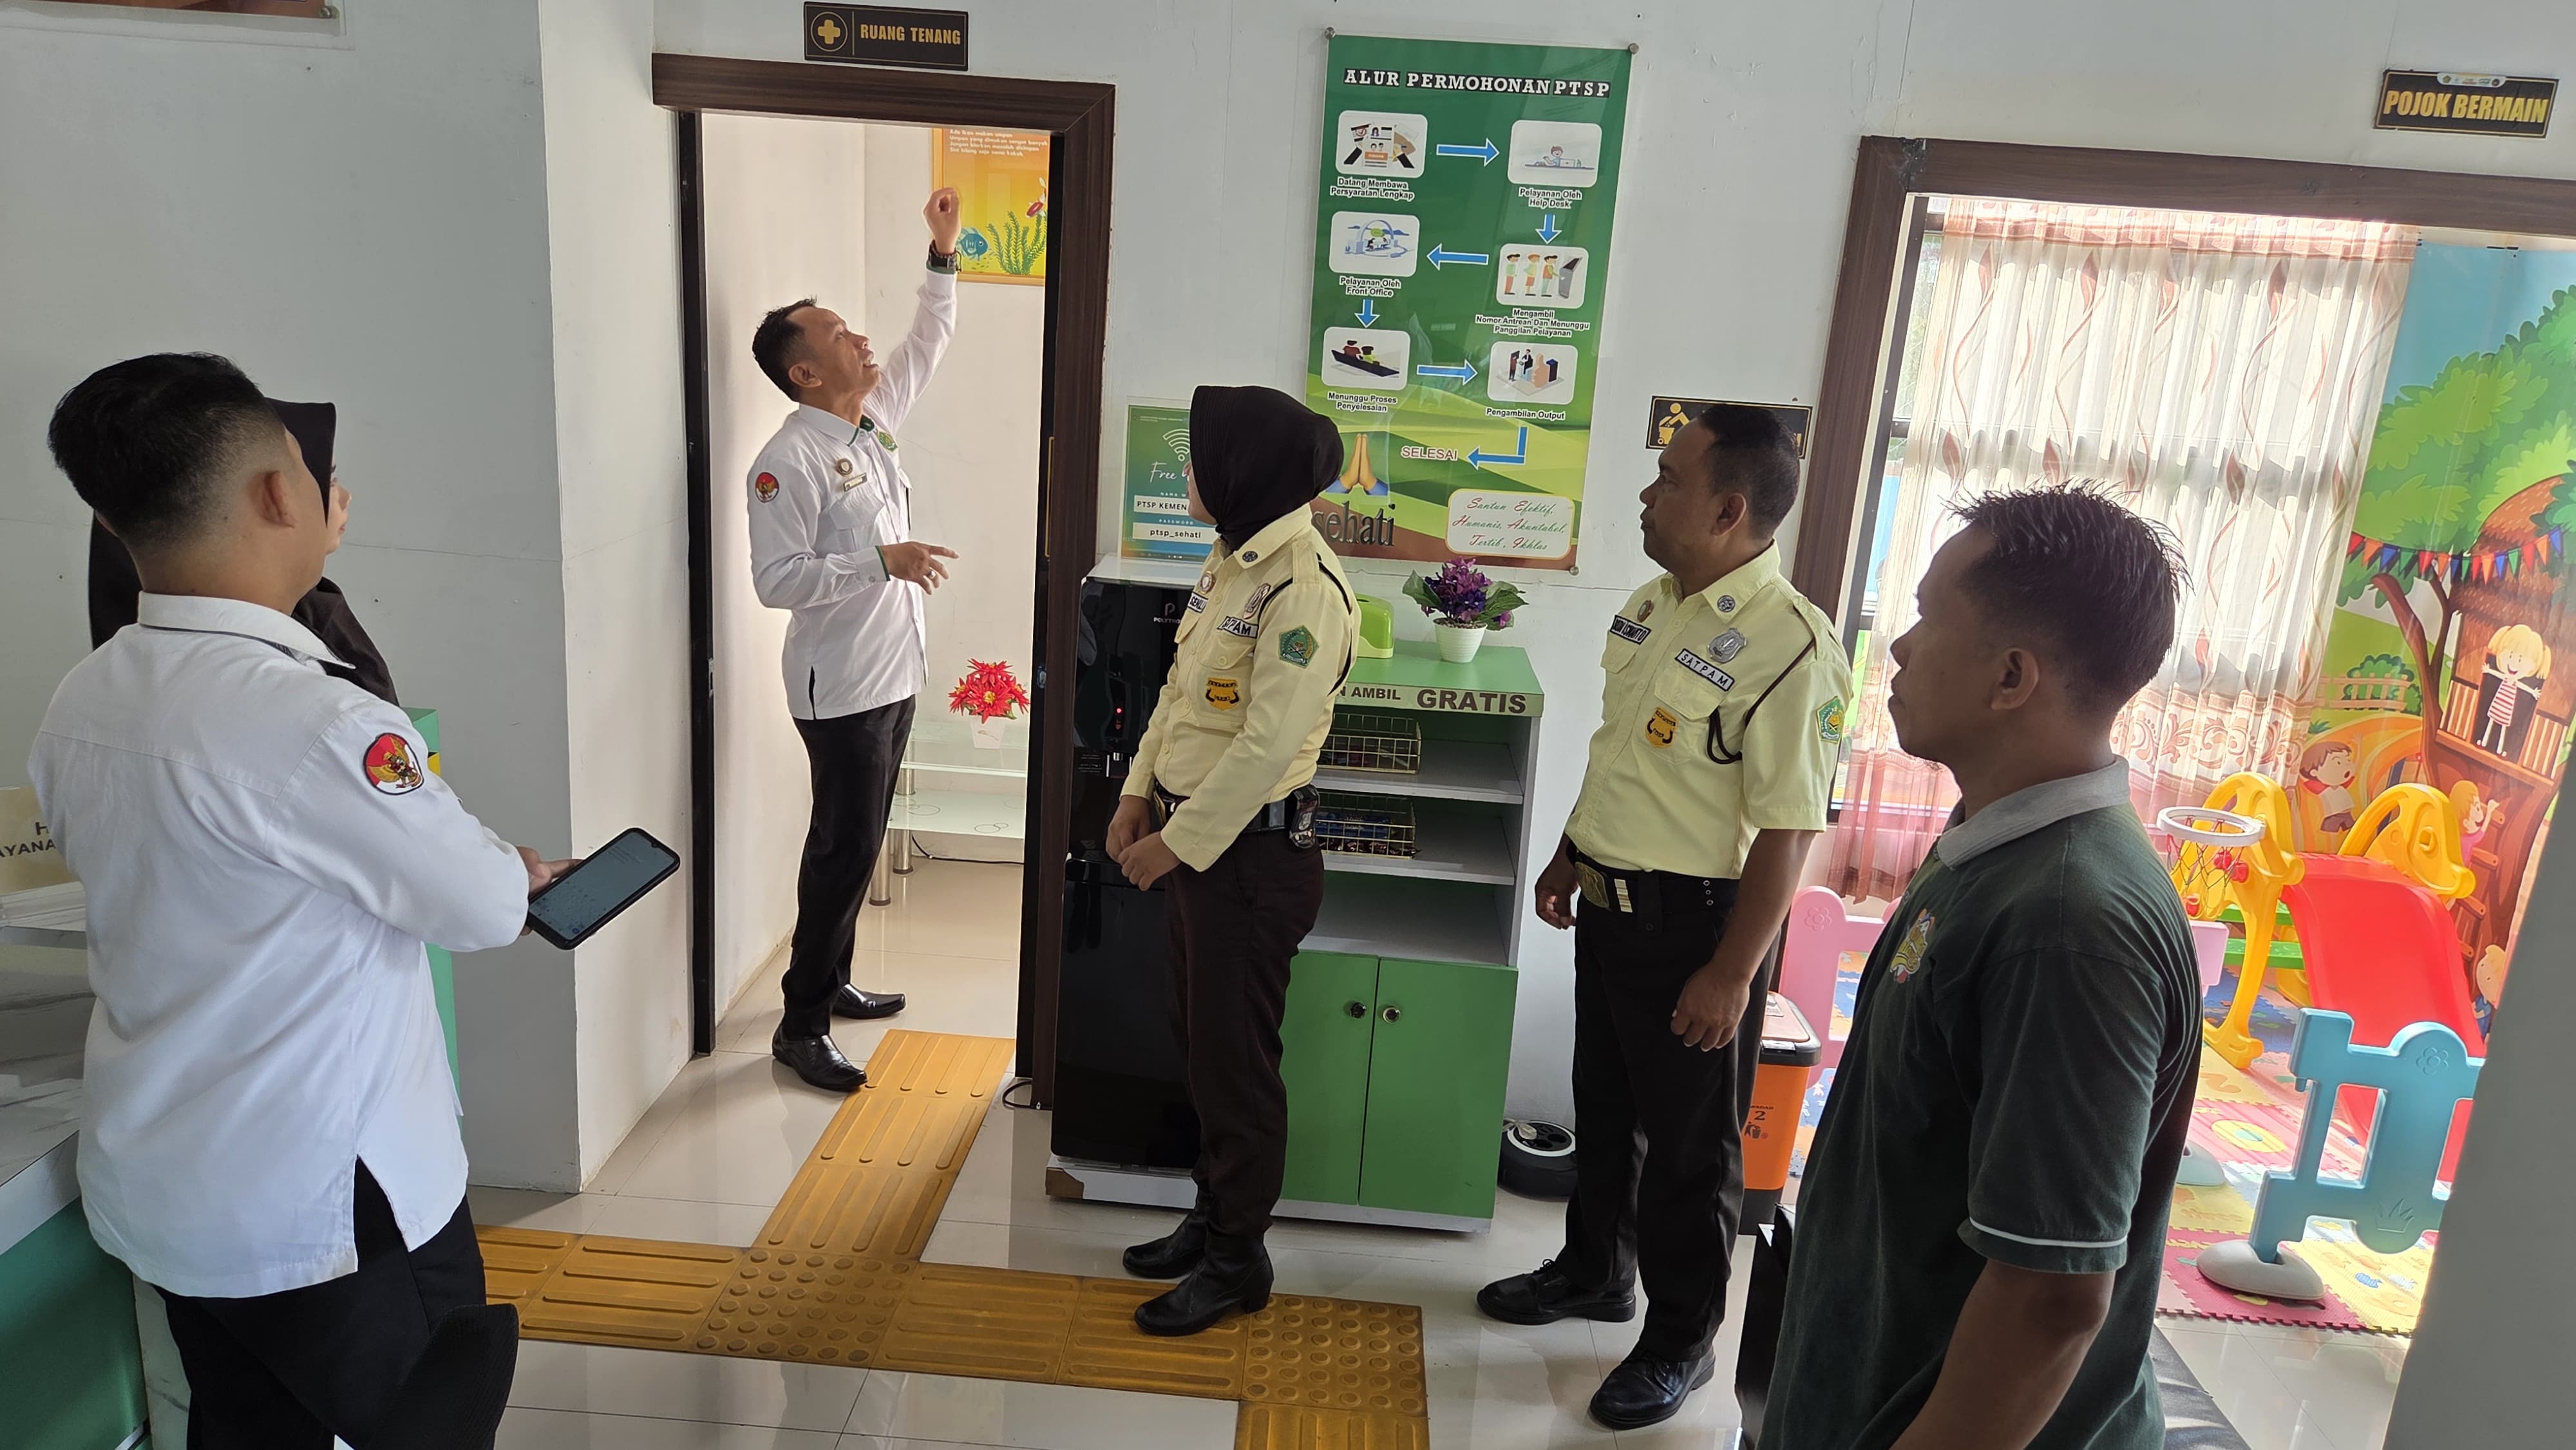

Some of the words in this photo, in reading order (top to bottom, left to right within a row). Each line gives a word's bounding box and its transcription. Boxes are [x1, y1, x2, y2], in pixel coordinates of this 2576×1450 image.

[860, 24, 905, 41] RUANG
[911, 27, 961, 44] TENANG
[1345, 70, 1399, 86] ALUR
[1407, 73, 1550, 94] PERMOHONAN
[1553, 80, 1610, 97] PTSP
[2383, 90, 2452, 117] POJOK
[2452, 94, 2548, 123] BERMAIN
[1338, 178, 1366, 188] Datang
[1368, 180, 1407, 189] Membawa
[1331, 187, 1377, 196] Persyaratan
[1379, 189, 1414, 200] Lengkap
[1520, 188, 1560, 198] Pelayanan
[1563, 191, 1581, 199] Oleh
[1530, 199, 1547, 207] Help
[1341, 277, 1380, 287] Pelayanan
[1369, 288, 1392, 296] Office
[1513, 309, 1554, 318] Mengambil
[1550, 321, 1589, 330] Menunggu
[1494, 326, 1531, 335] Panggilan
[1533, 328, 1571, 337] Pelayanan
[1329, 393, 1368, 402] Menunggu
[1337, 402, 1387, 411] Penyelesaian
[1486, 408, 1536, 418] Pengambilan
[1538, 411, 1565, 420] Output
[1401, 447, 1457, 460] SELESAI
[1150, 461, 1177, 483] Free
[1137, 500, 1156, 509] PTSP
[1159, 502, 1187, 511] KEMEN
[1467, 497, 1507, 510] Santun
[1311, 500, 1396, 547] sehati
[1681, 654, 1728, 686] SATPAM
[1351, 686, 1401, 701] AMBIL
[1417, 689, 1526, 714] GRATIS
[1754, 1110, 1766, 1120] 2
